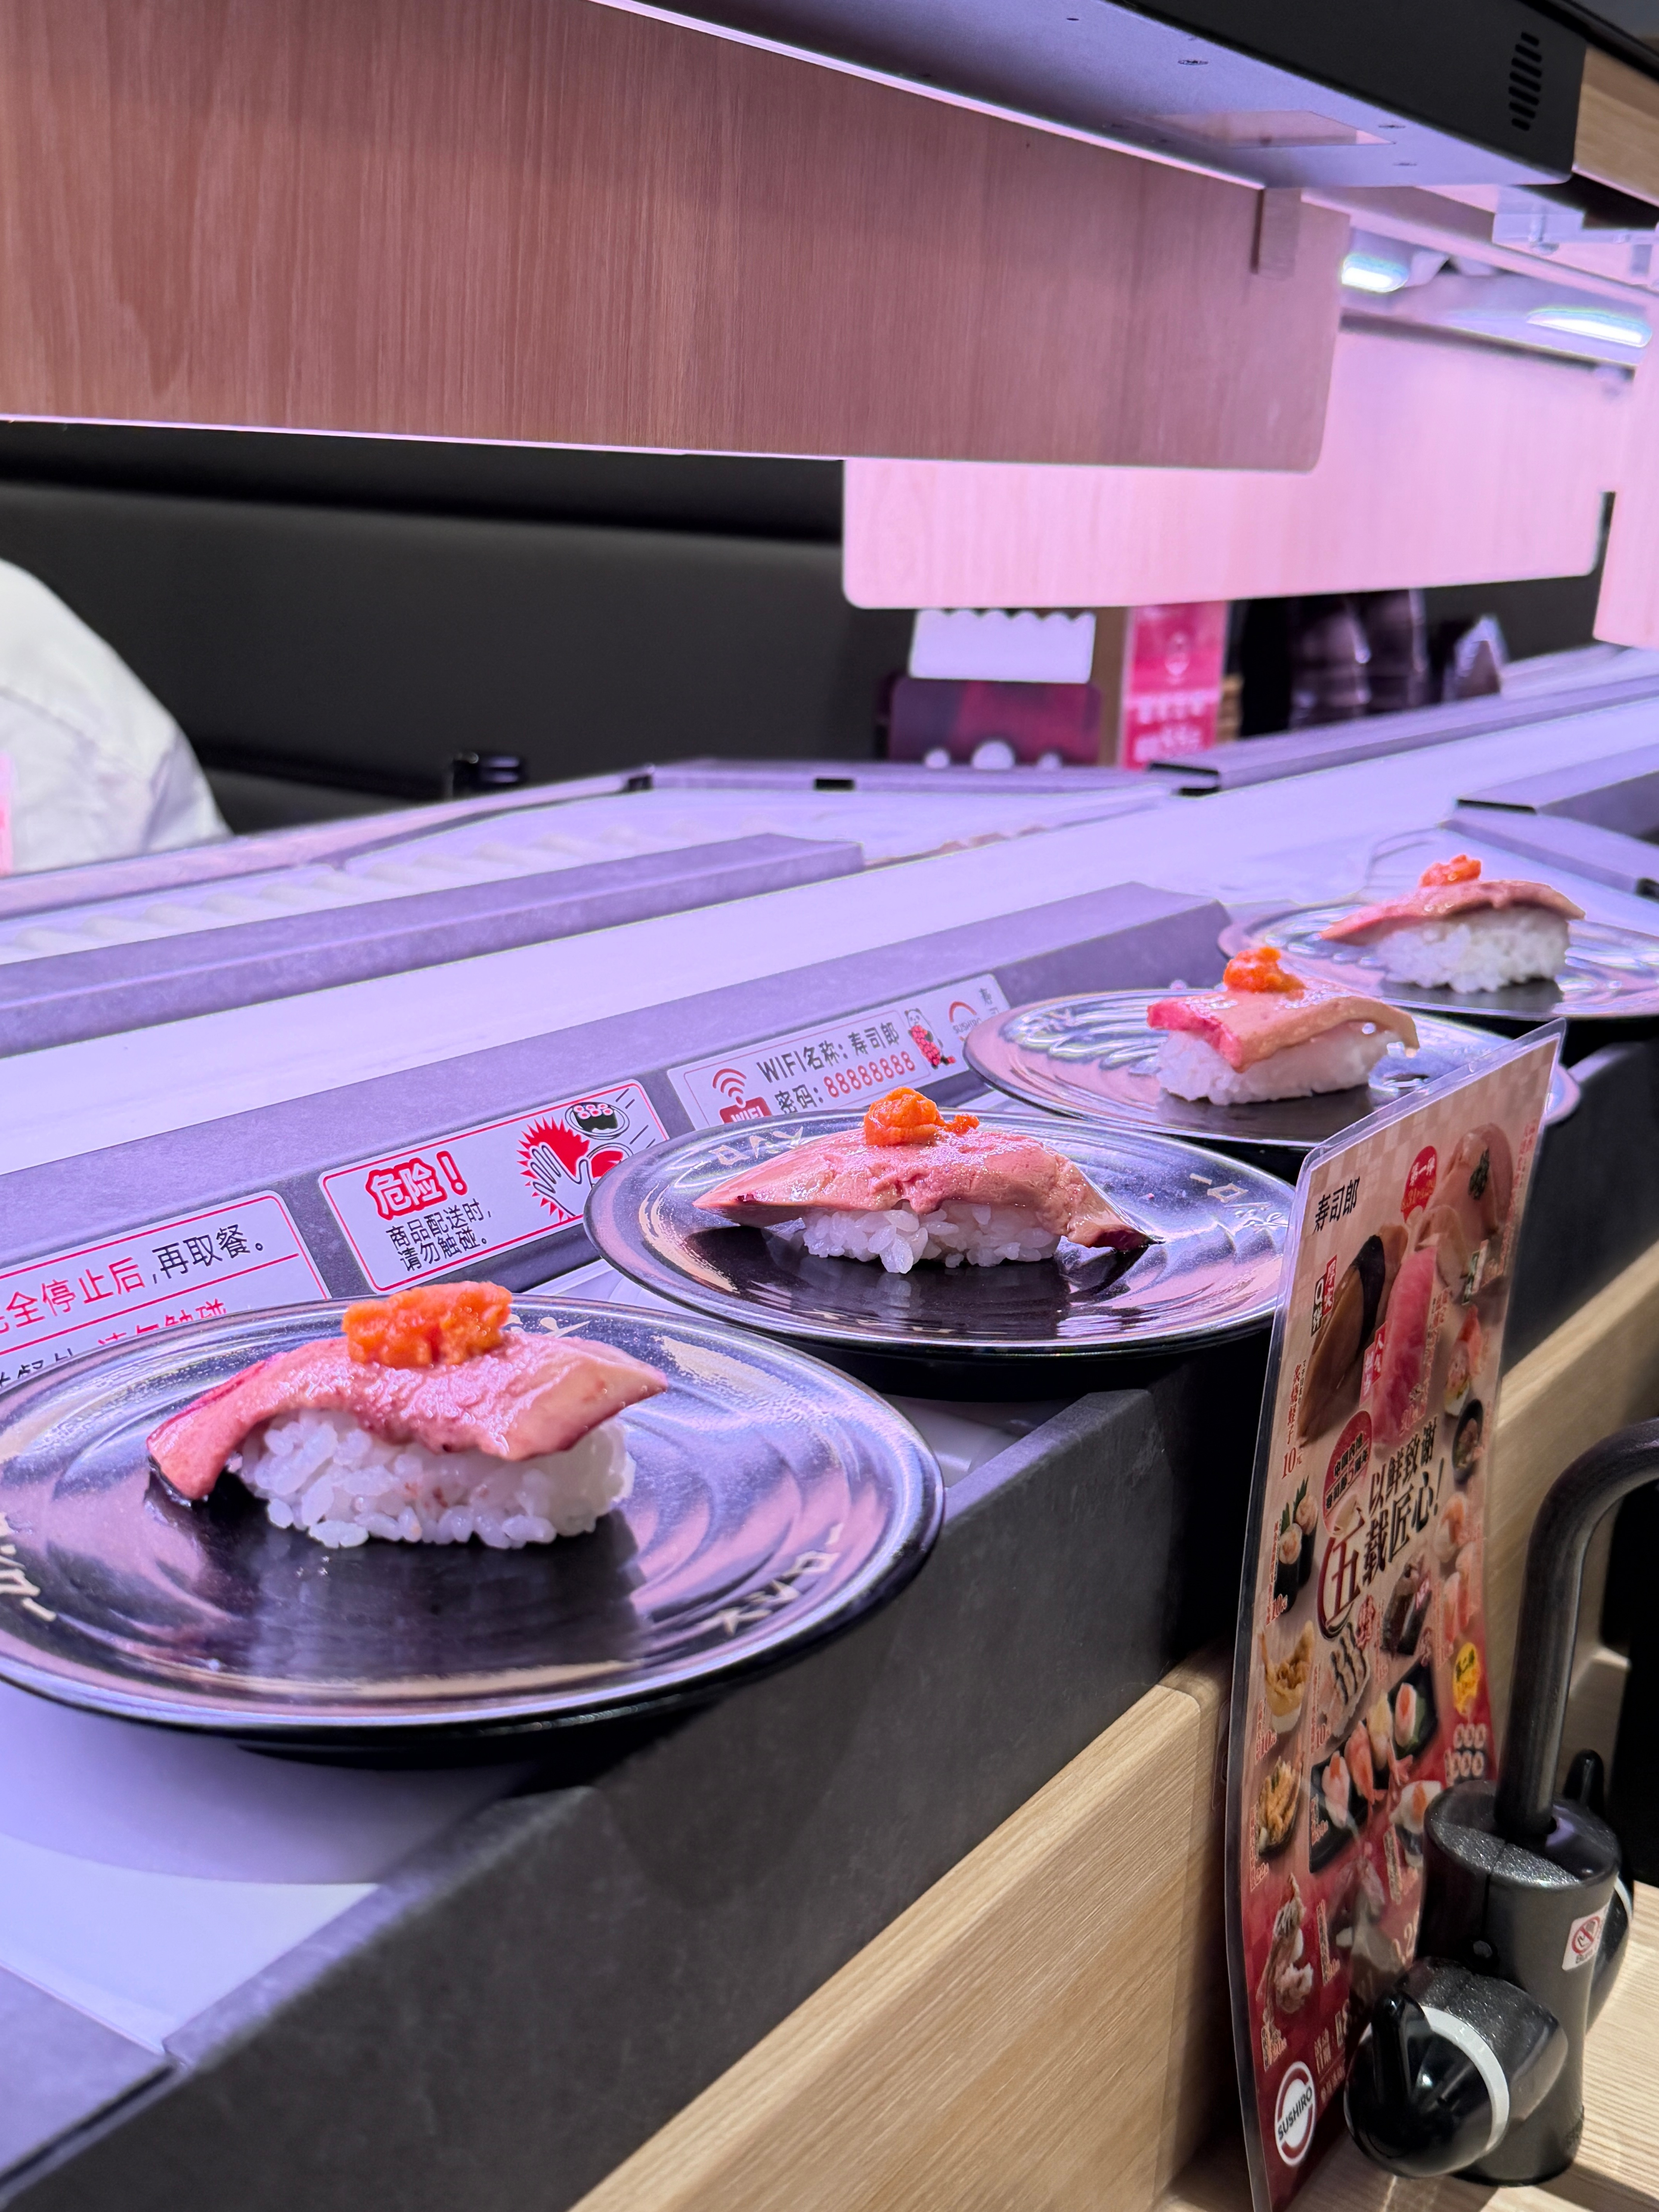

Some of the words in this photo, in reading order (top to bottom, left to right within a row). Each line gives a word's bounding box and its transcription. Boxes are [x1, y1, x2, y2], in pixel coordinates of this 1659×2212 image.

[1312, 1176, 1360, 1235] 寿司郎
[0, 1224, 263, 1334] 全停止后，再取餐。
[1369, 1416, 1437, 1518] 以鲜致谢
[1278, 2087, 1312, 2140] SUSHIRO
